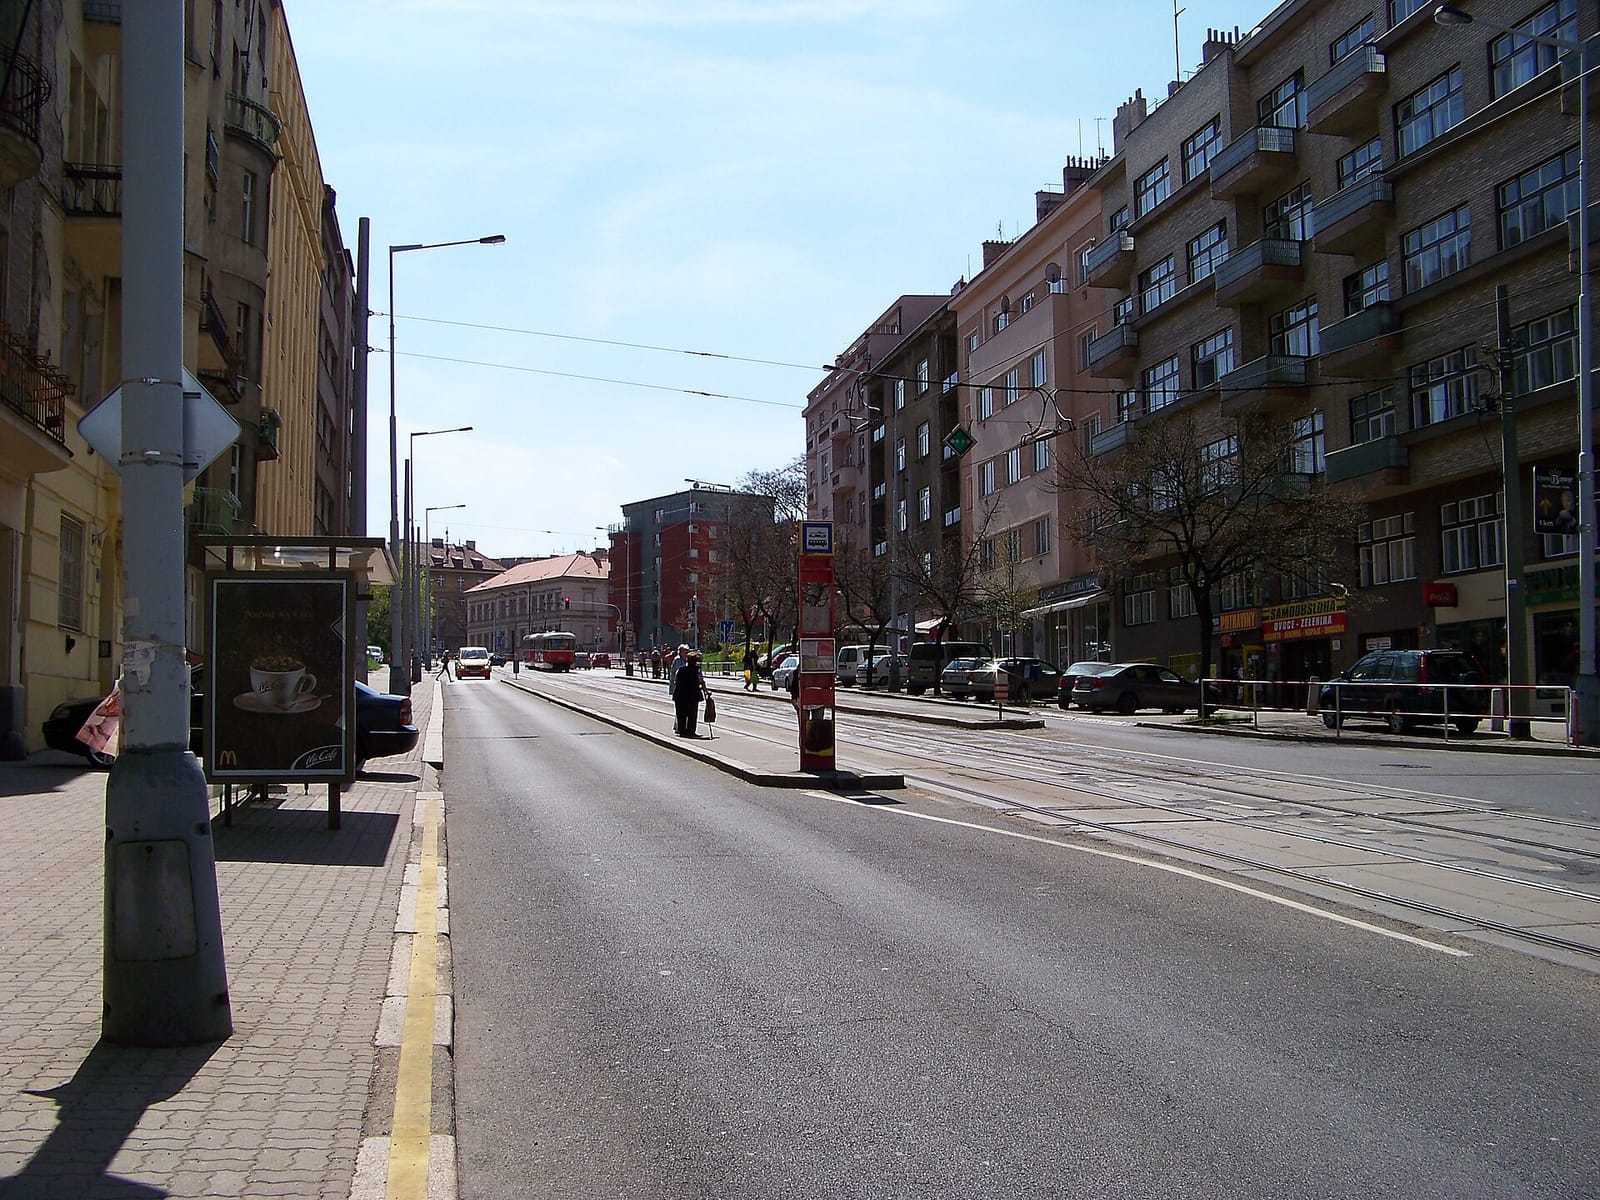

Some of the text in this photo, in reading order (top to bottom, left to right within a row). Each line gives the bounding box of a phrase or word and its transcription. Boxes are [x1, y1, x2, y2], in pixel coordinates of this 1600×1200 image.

[1220, 609, 1256, 630] POTRAVINY
[1270, 599, 1336, 620] SAMOOBSLUHA
[1273, 615, 1333, 631] OVOCE ZELENINA
